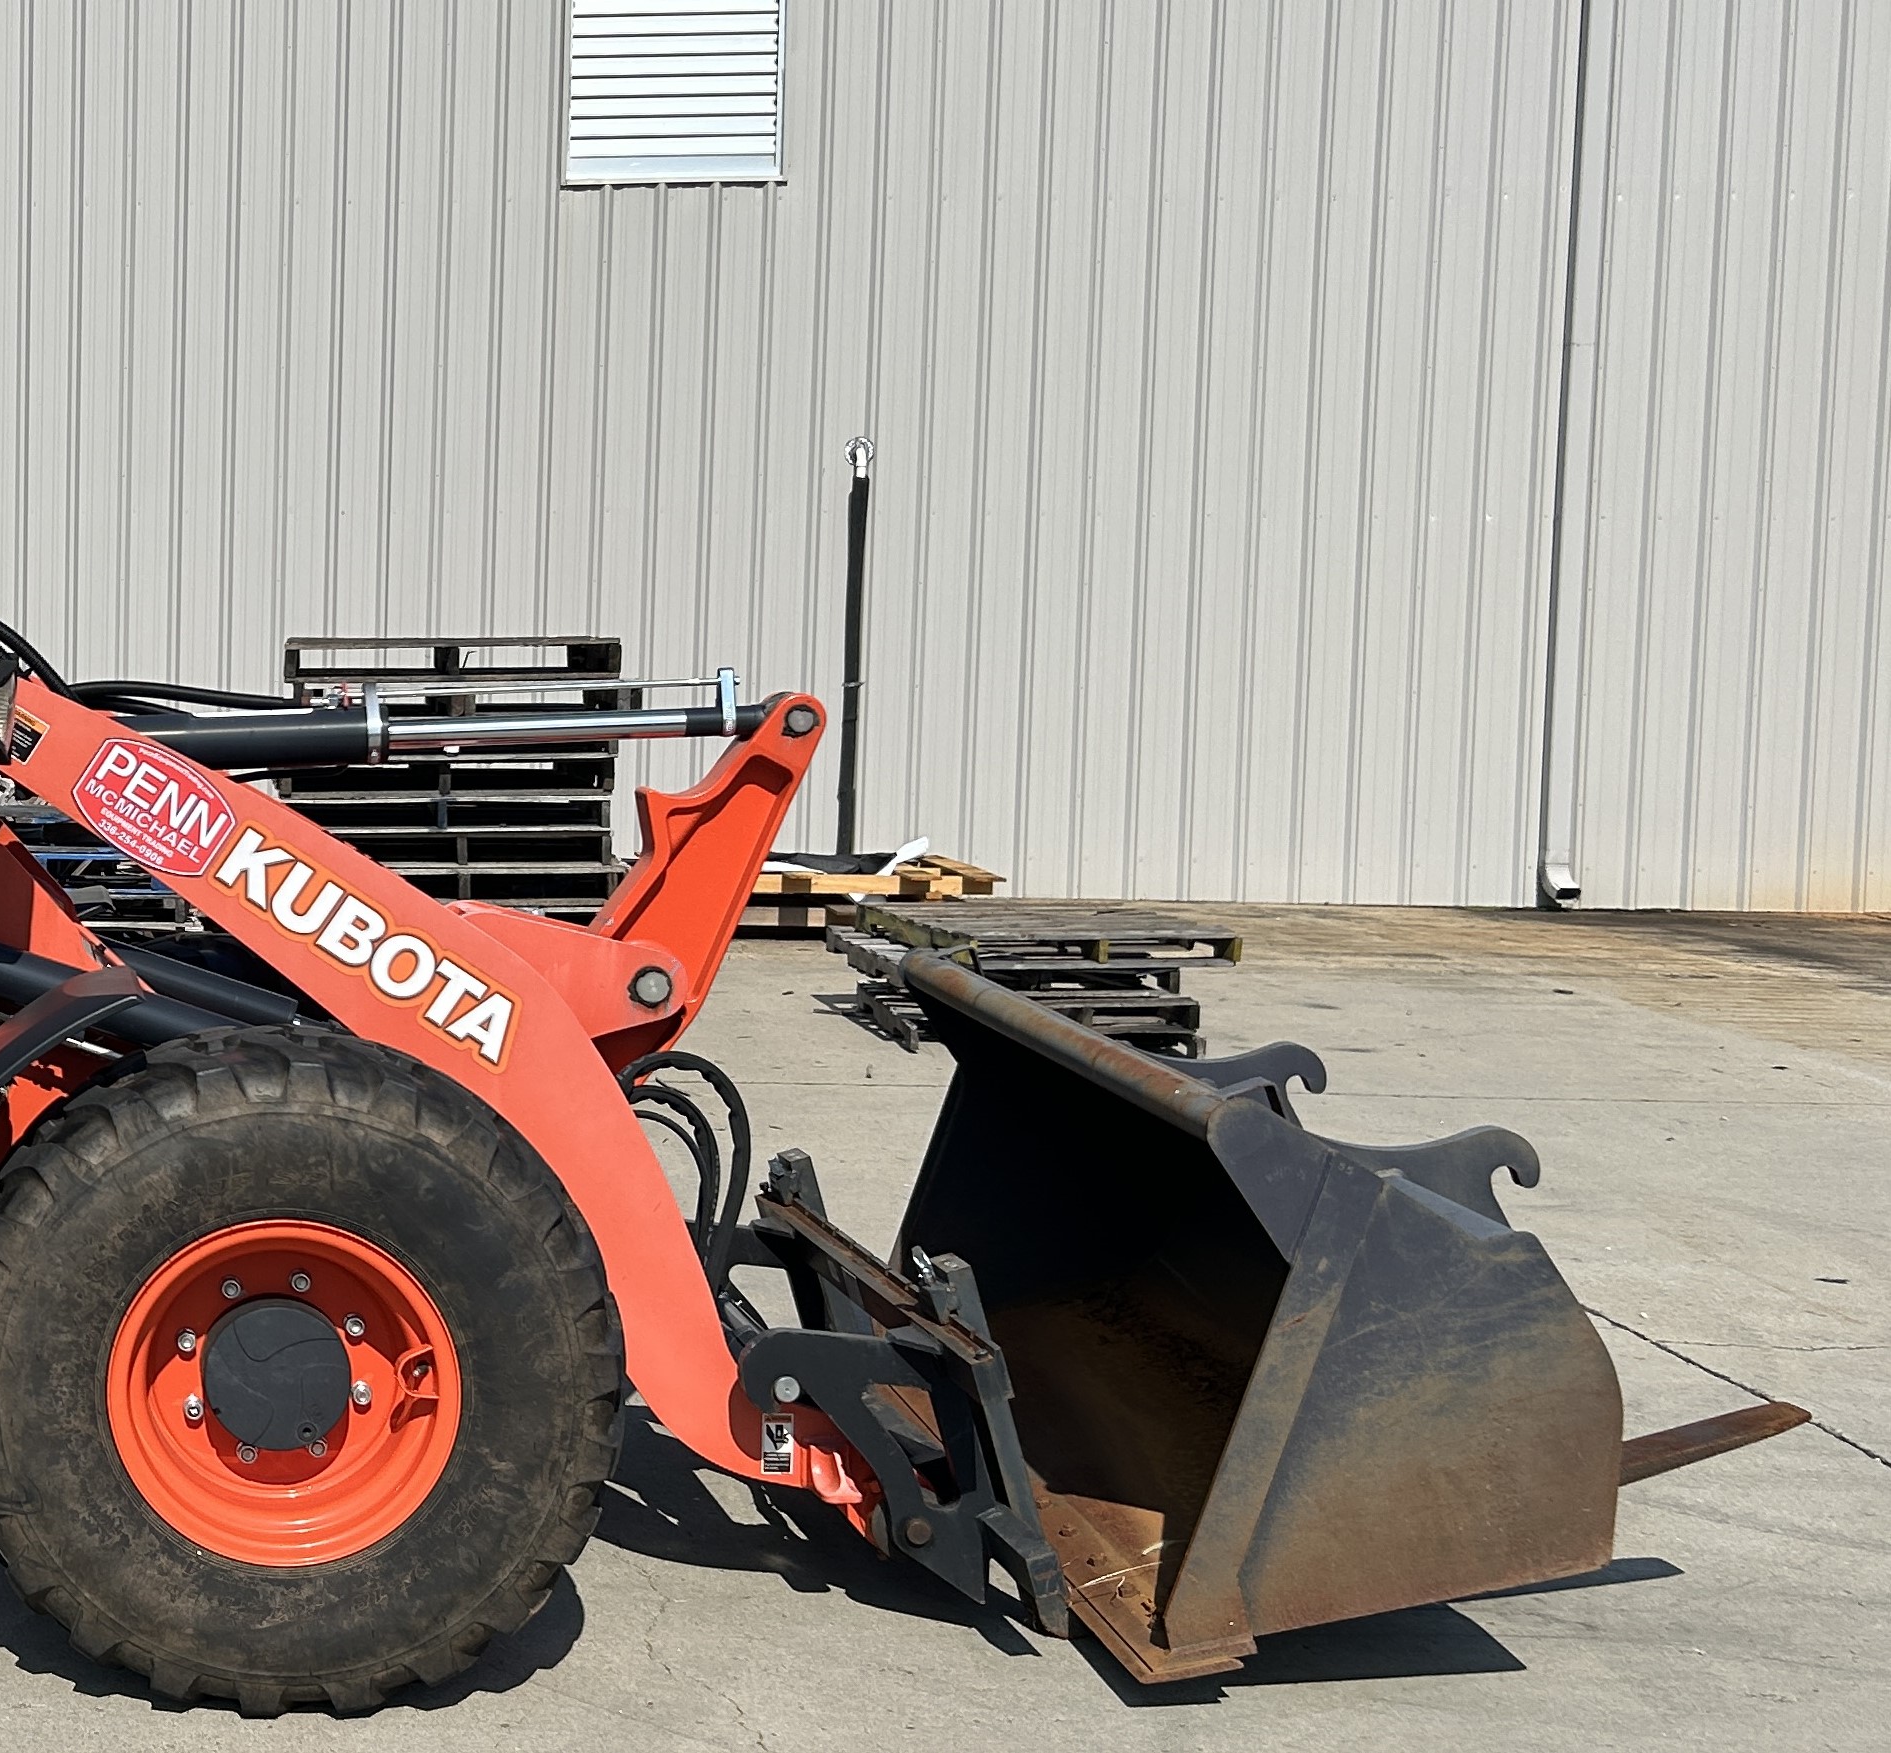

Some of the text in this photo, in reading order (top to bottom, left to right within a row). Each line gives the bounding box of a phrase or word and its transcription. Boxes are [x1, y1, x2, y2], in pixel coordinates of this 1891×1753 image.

[84, 778, 201, 863] MCMICHAEL
[94, 744, 228, 849] PENN
[100, 807, 174, 858] EQUIPMENT TRADING
[214, 826, 514, 1066] KUBOTA
